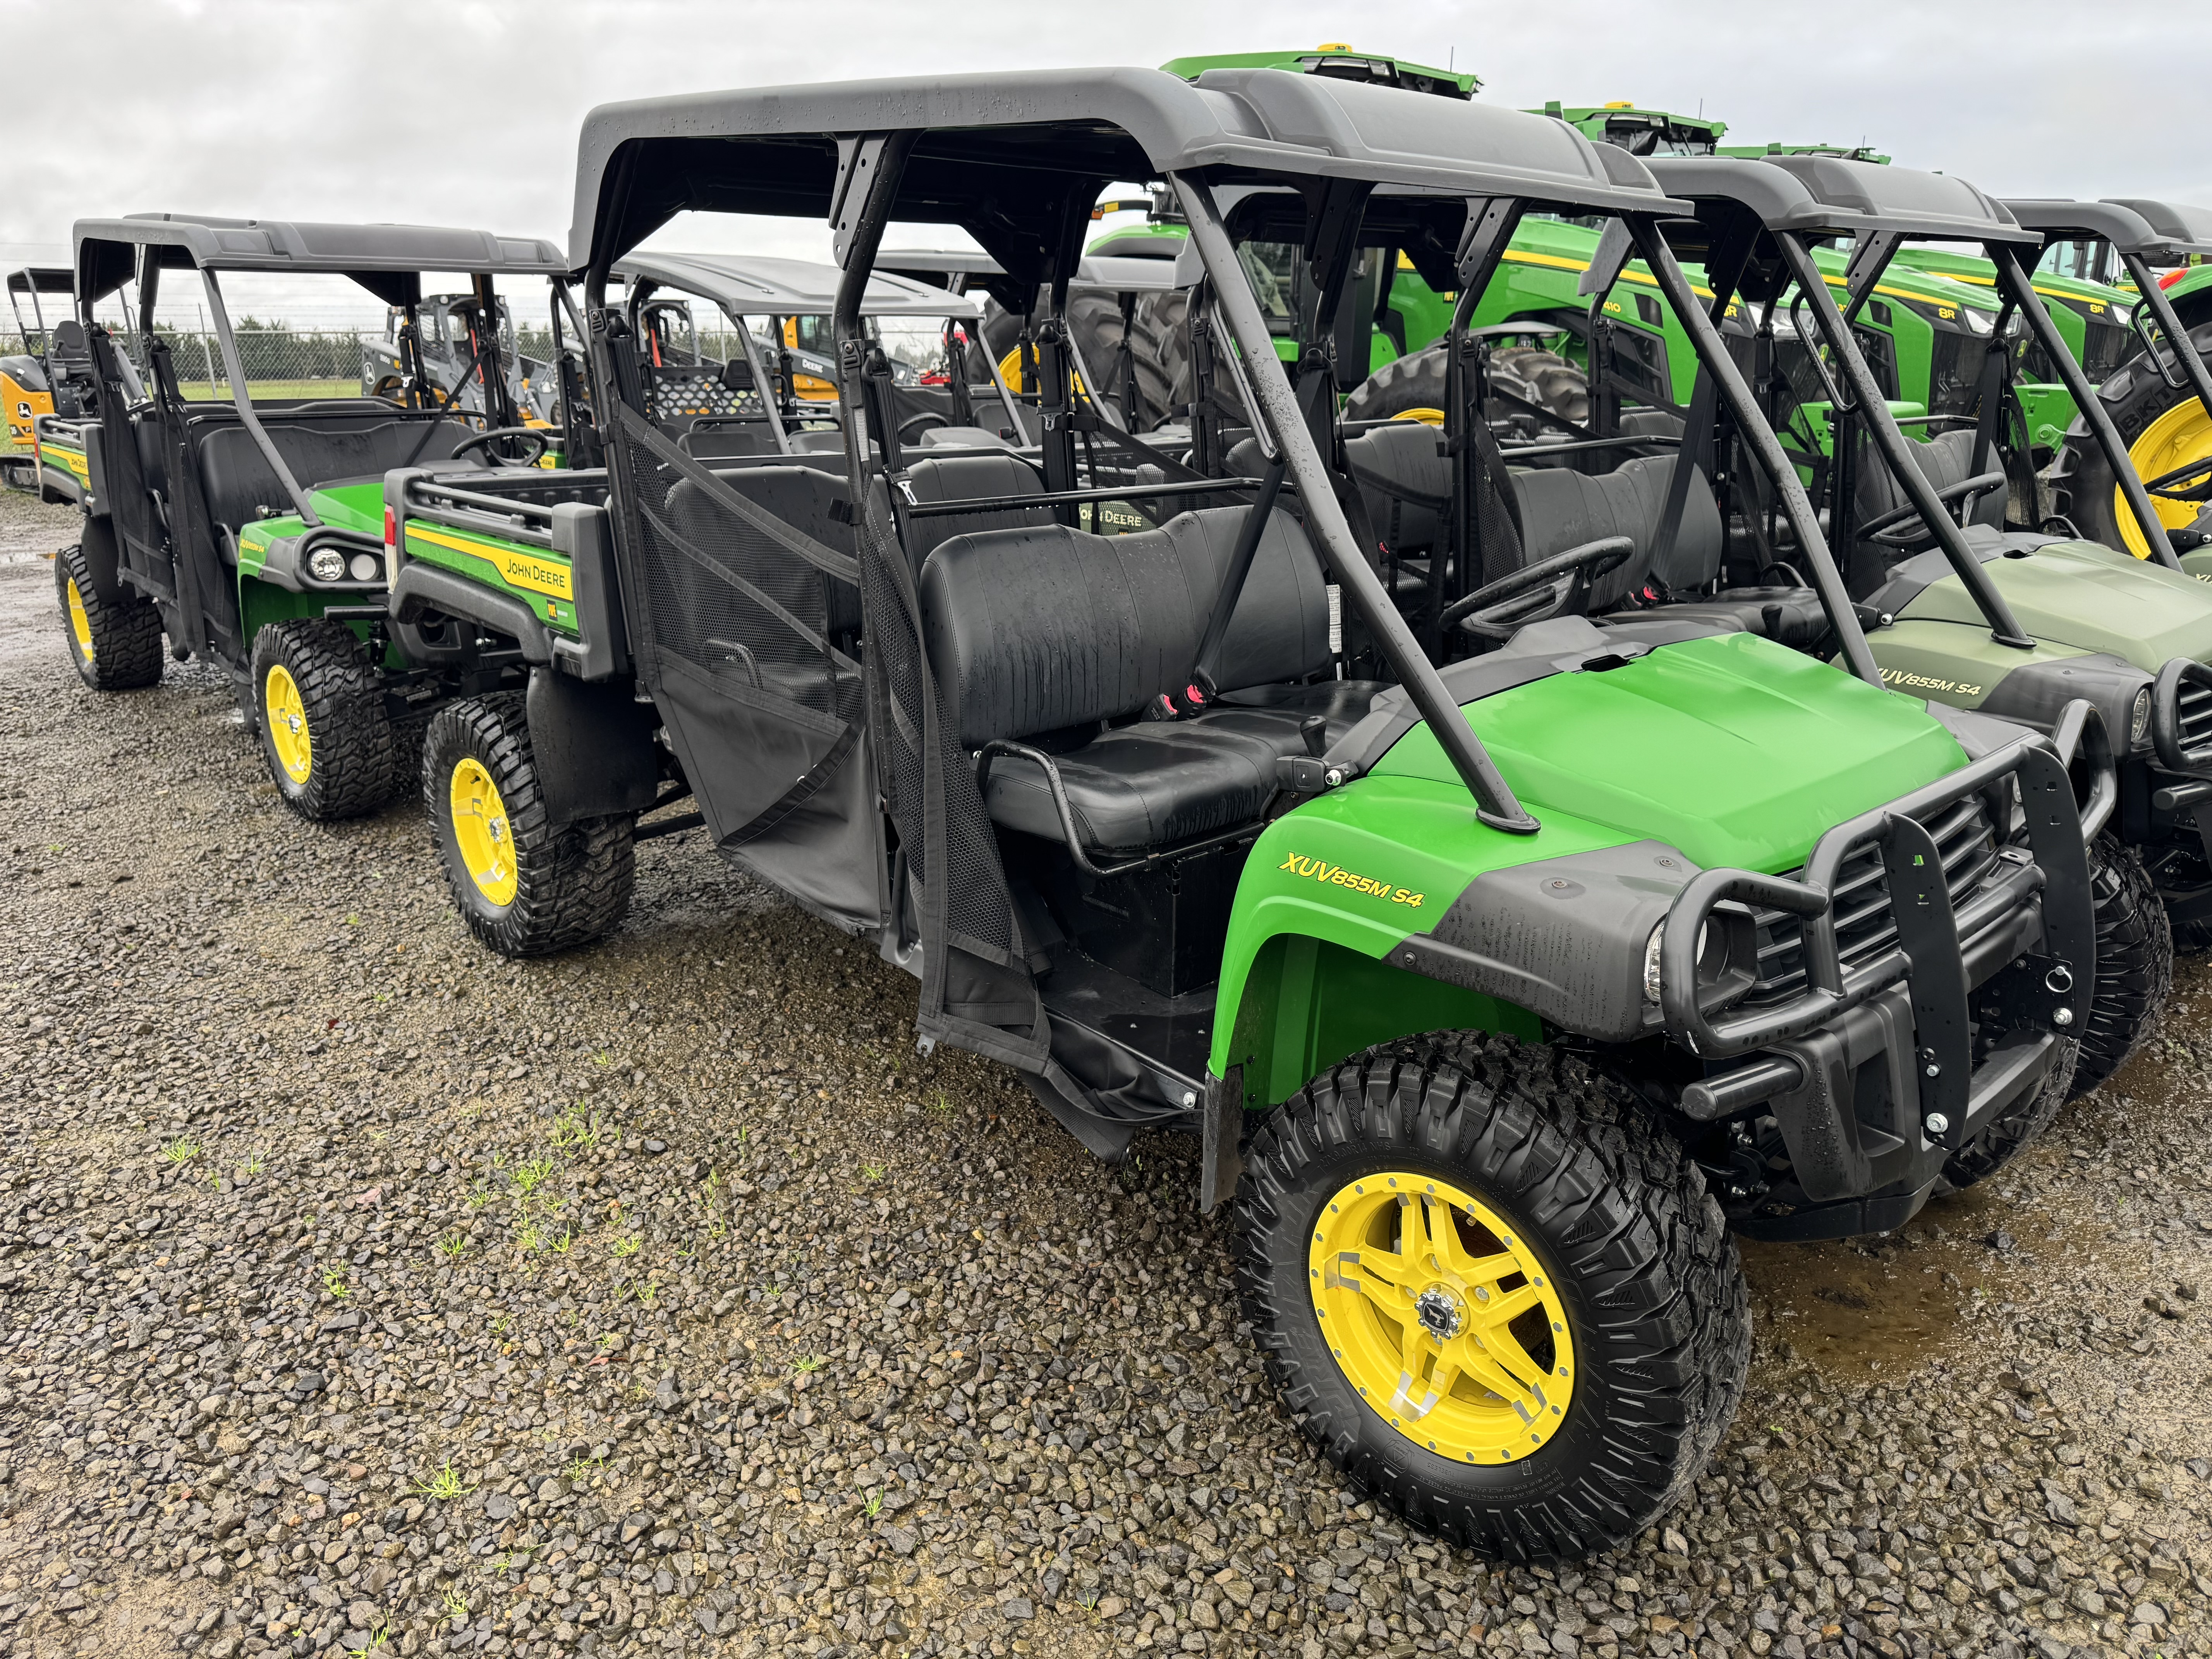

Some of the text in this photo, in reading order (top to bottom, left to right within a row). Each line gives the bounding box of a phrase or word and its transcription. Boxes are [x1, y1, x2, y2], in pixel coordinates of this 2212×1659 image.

[1604, 301, 1621, 313] 410
[1939, 307, 1955, 319] 8R
[2090, 304, 2104, 313] 8R
[1105, 510, 1142, 527] DEERE
[507, 559, 565, 588] JOHN DEERE
[1878, 668, 1981, 696] UV855M S4
[1278, 852, 1426, 907] XUV855M S4
[1369, 1140, 1392, 1151] NHS
[1427, 1462, 1454, 1477] TUBELESS
